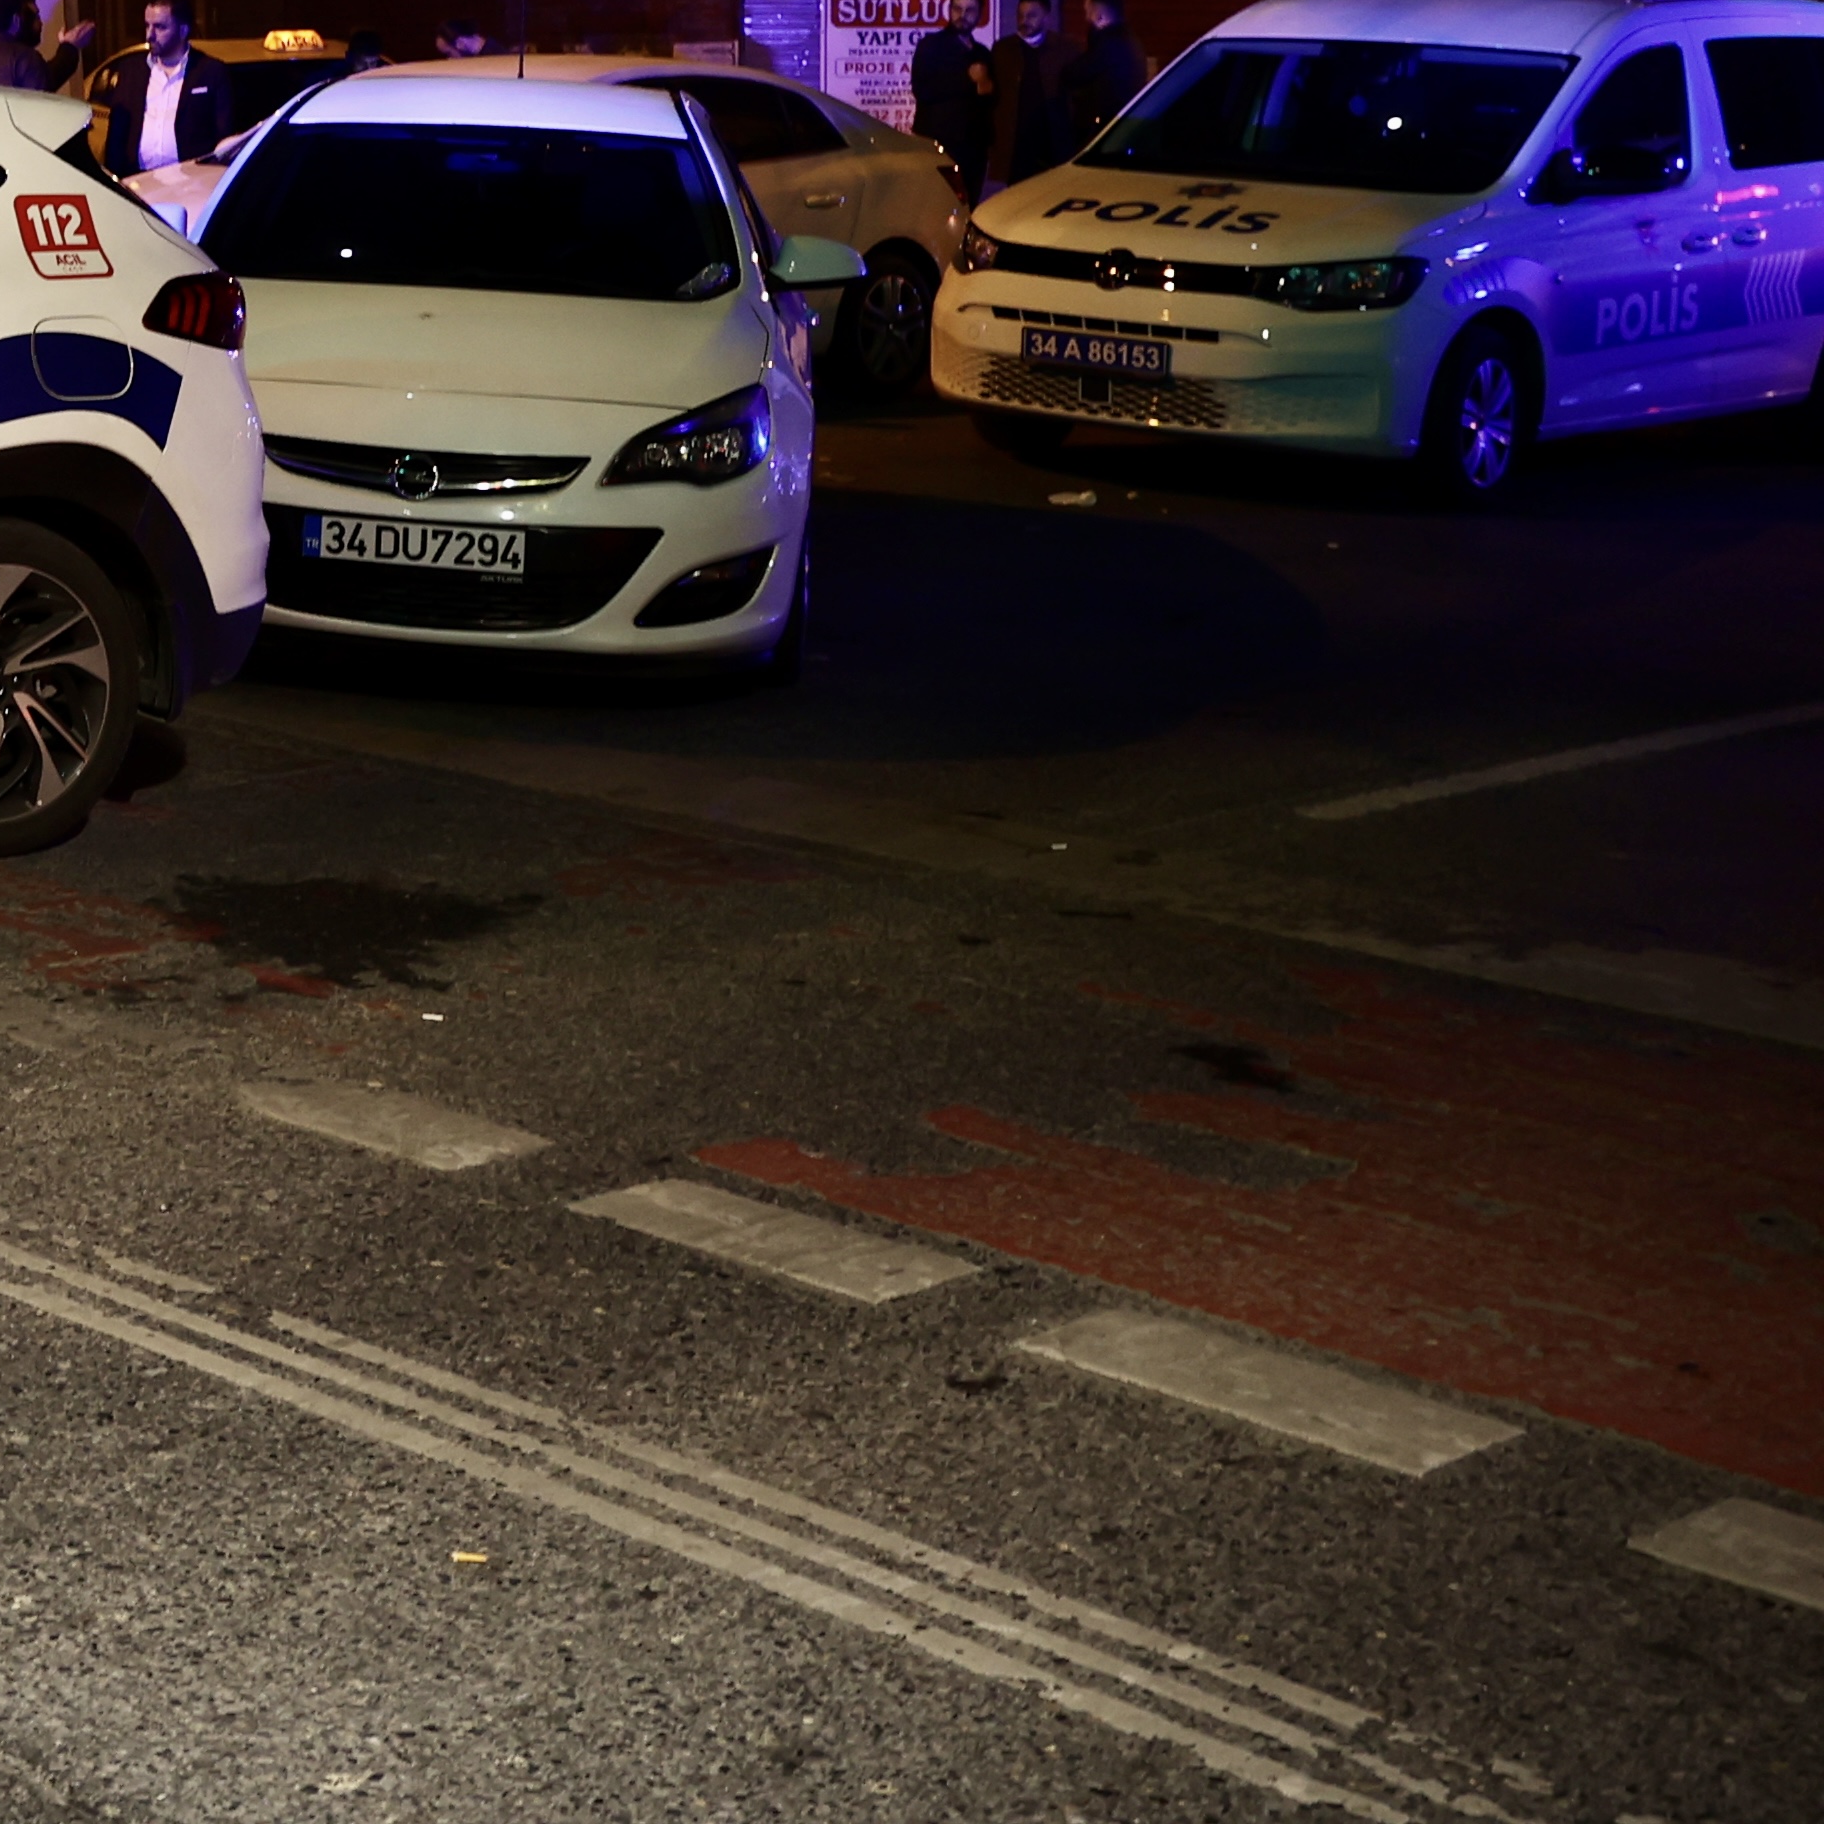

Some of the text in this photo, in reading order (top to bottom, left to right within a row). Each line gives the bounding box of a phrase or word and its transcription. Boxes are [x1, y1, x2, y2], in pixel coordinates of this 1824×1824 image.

[857, 31, 901, 46] YAPI
[844, 62, 895, 75] PROJE
[26, 203, 89, 246] 112
[1043, 198, 1280, 233] POLİS
[1595, 271, 1699, 345] POLİS
[1030, 332, 1161, 371] 34 A 86153
[325, 521, 367, 556] 34
